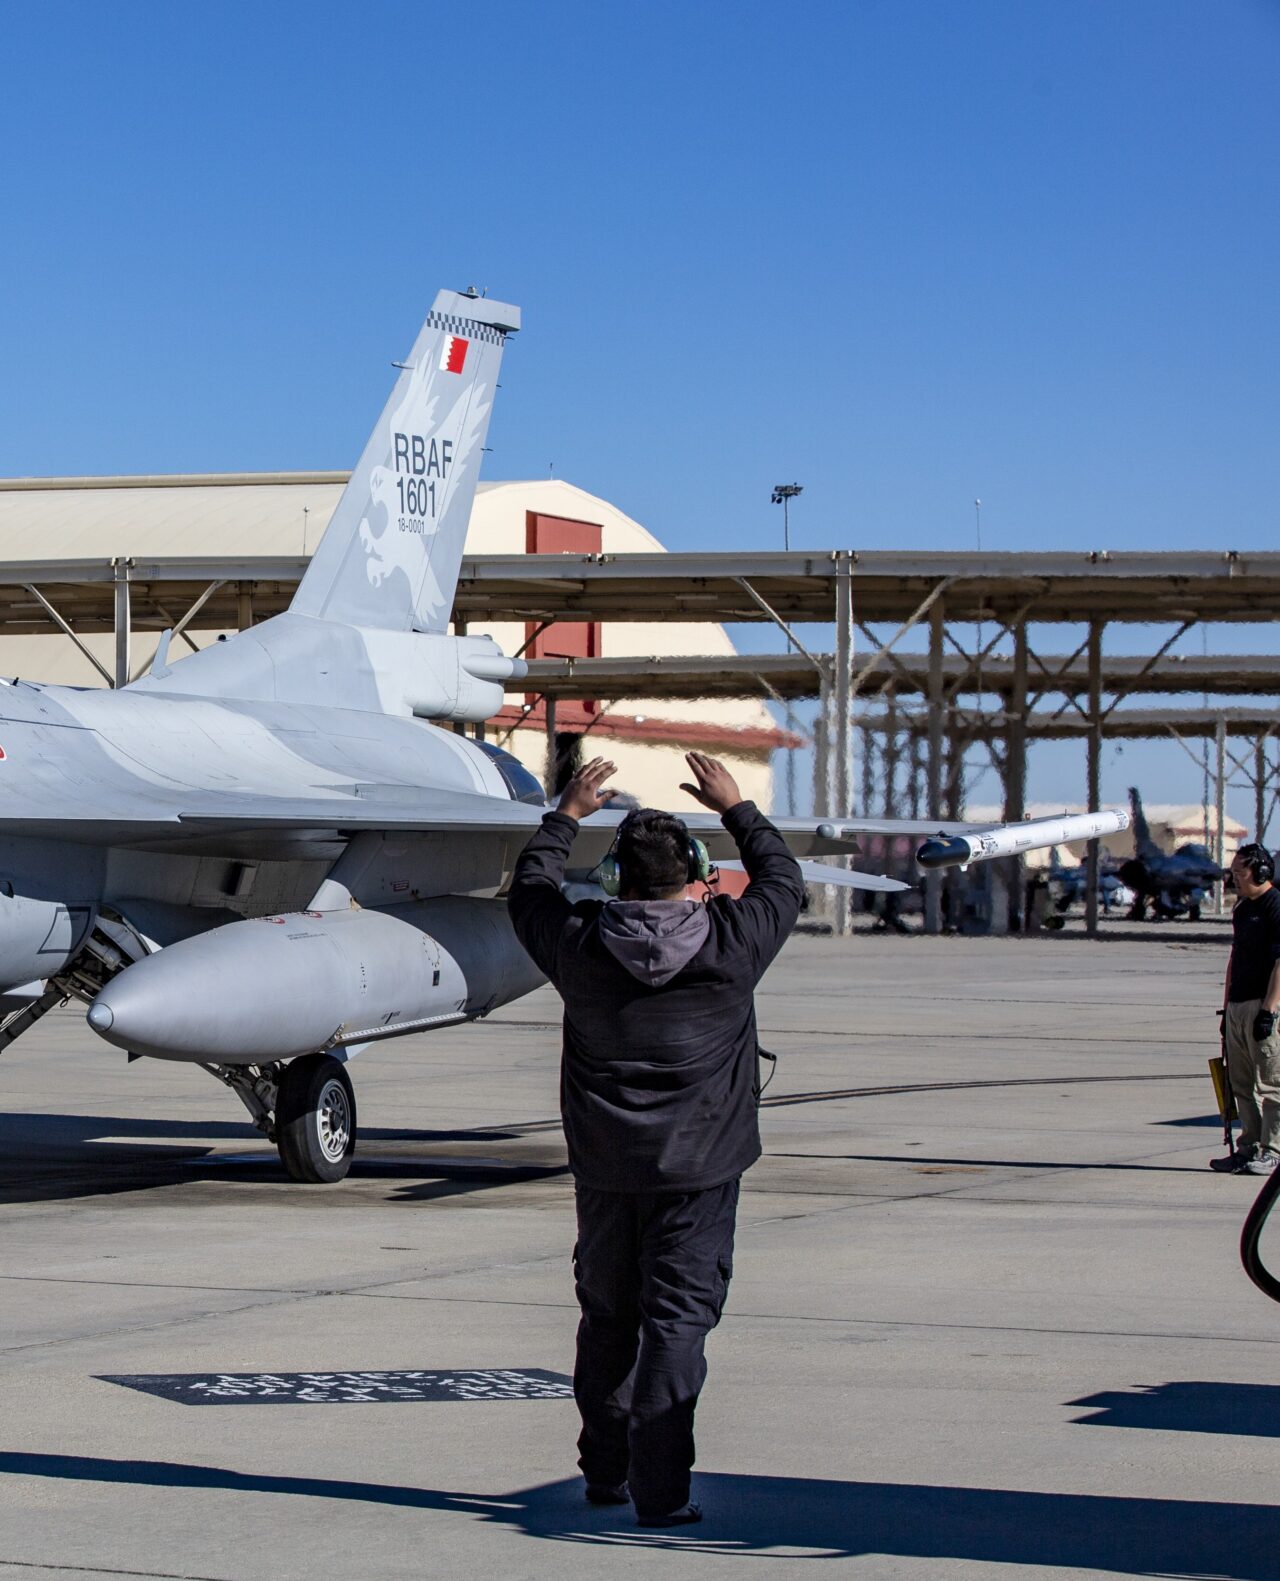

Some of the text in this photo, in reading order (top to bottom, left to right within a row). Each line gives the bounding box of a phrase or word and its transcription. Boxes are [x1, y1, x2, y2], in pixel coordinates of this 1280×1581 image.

[394, 432, 453, 479] RBAF
[396, 476, 435, 518] 1601
[398, 518, 425, 534] 18-0001
[215, 1370, 526, 1382] EL 2314 FT
[296, 1394, 380, 1402] P3
